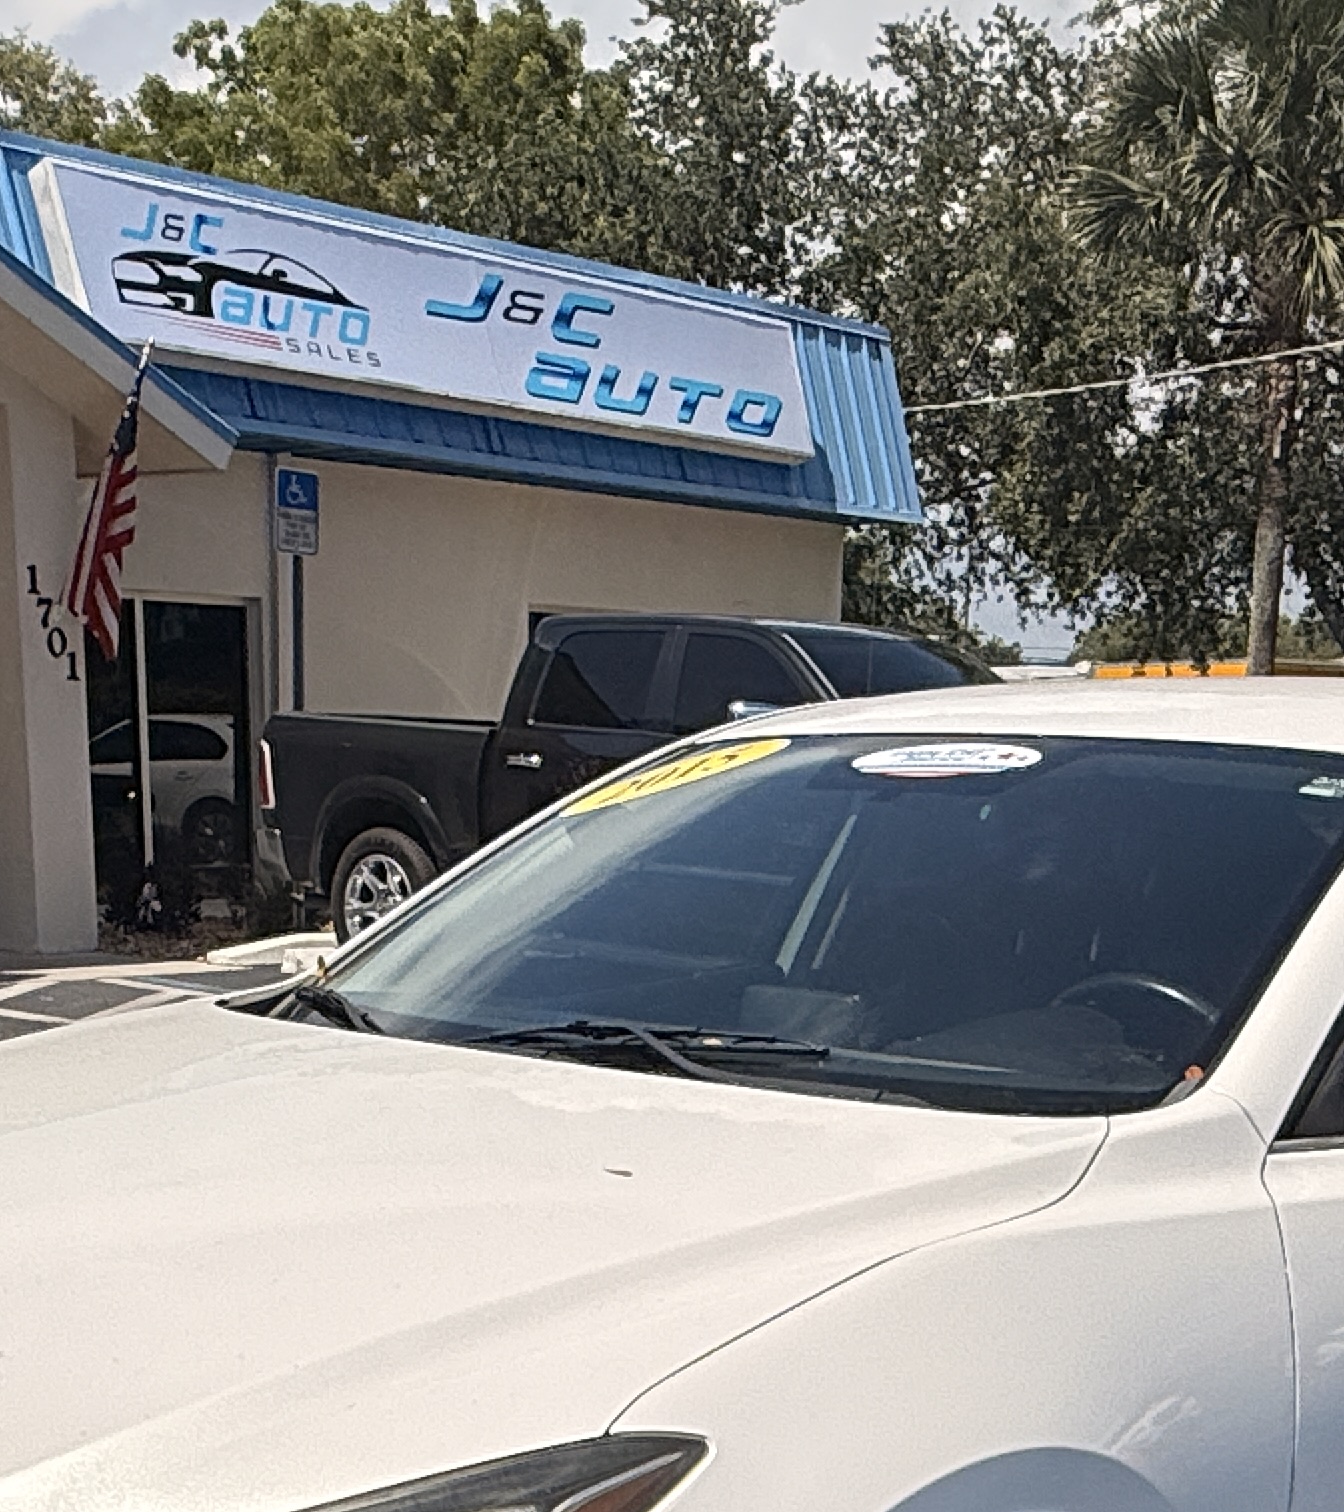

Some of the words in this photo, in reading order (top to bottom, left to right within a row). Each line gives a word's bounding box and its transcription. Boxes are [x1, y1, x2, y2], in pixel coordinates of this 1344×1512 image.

[120, 203, 225, 254] J&C
[425, 273, 615, 348] J&C
[283, 337, 382, 368] SALES
[27, 565, 81, 682] 1701
